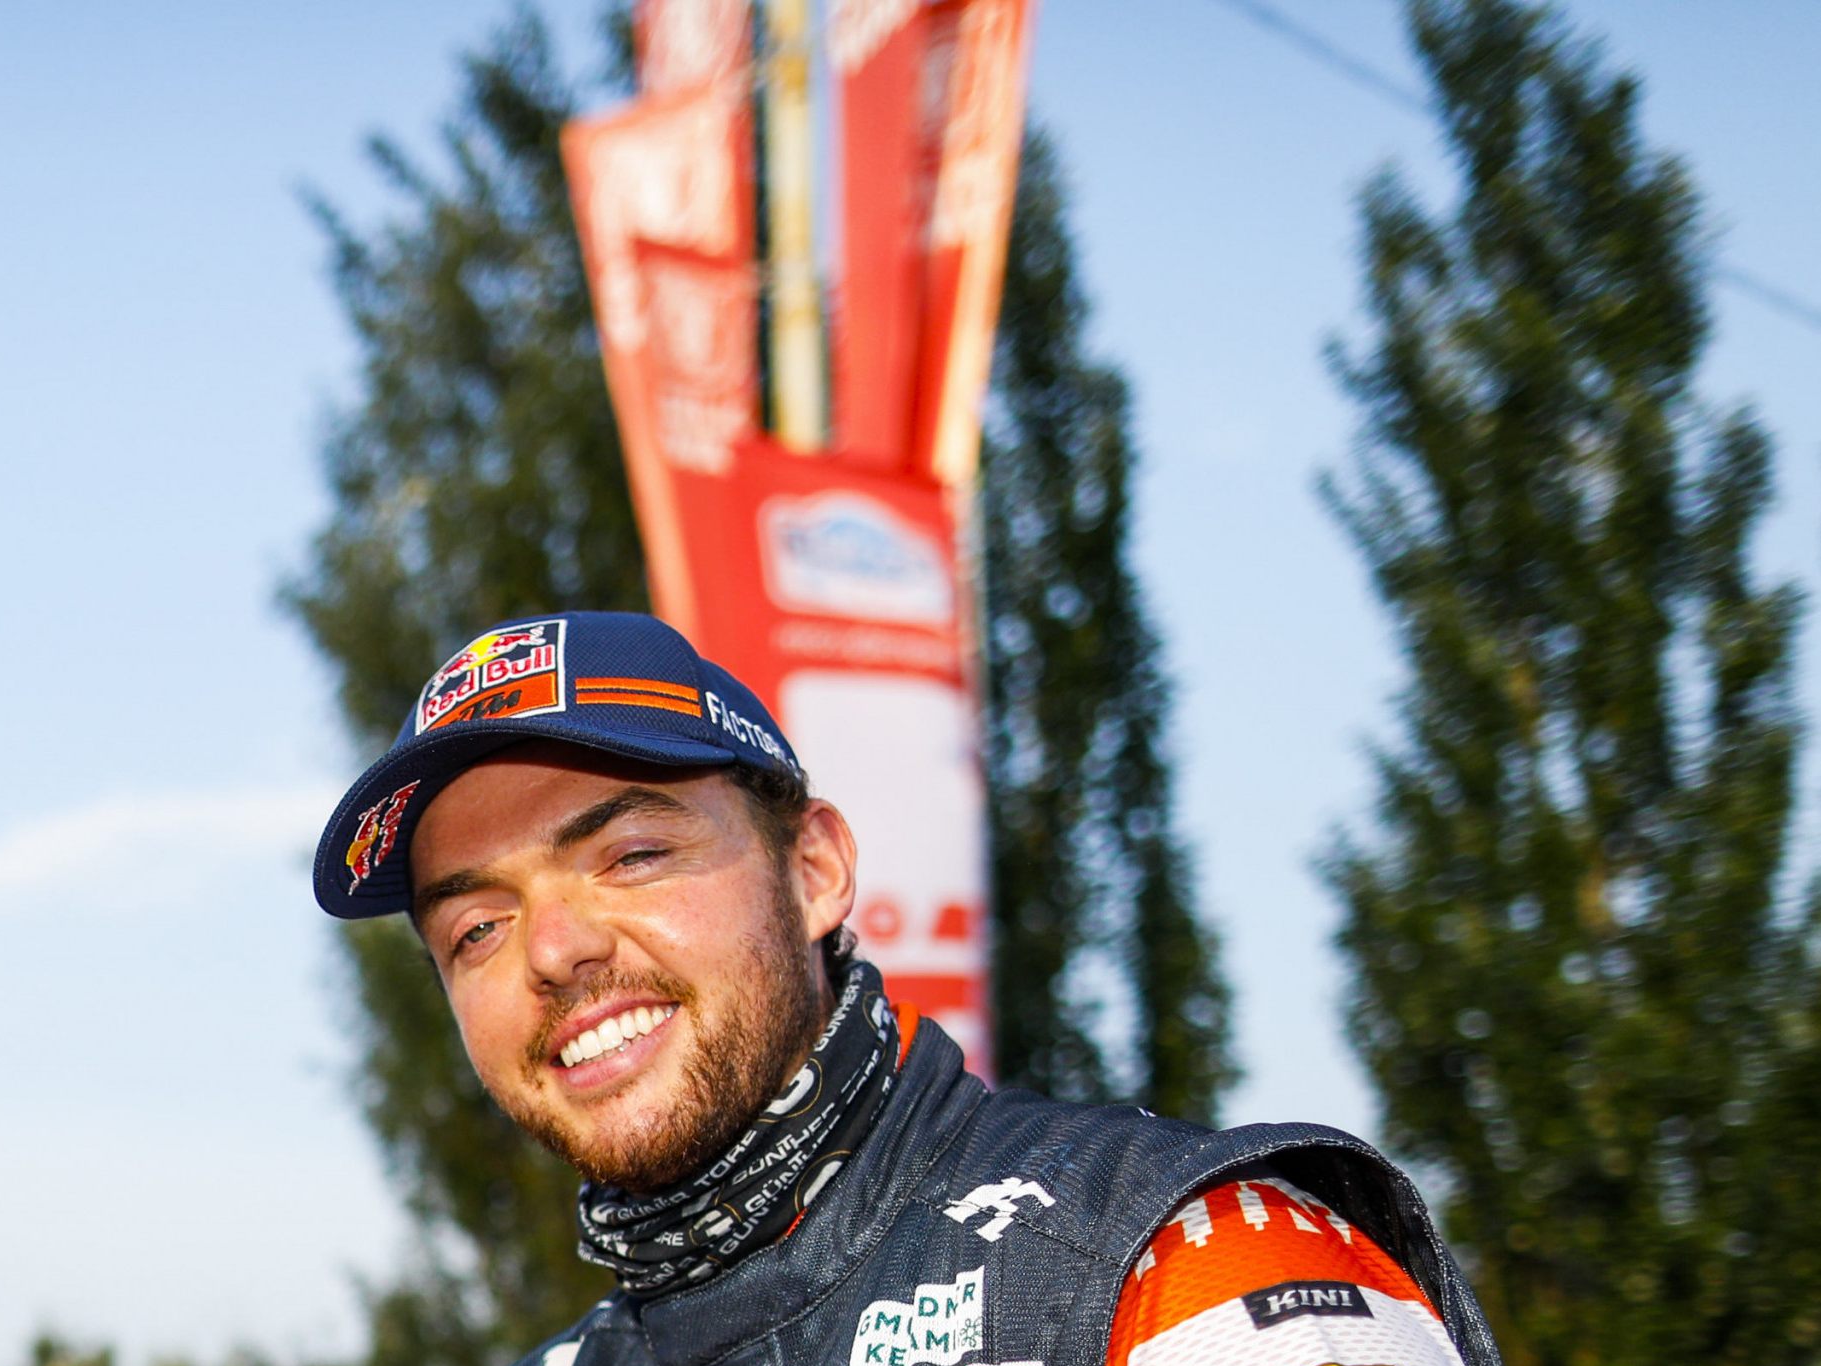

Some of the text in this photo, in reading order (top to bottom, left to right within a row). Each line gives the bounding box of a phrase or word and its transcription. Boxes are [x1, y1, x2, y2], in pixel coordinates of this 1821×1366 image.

[421, 643, 556, 727] Red Bull
[1266, 1289, 1353, 1316] KINI
